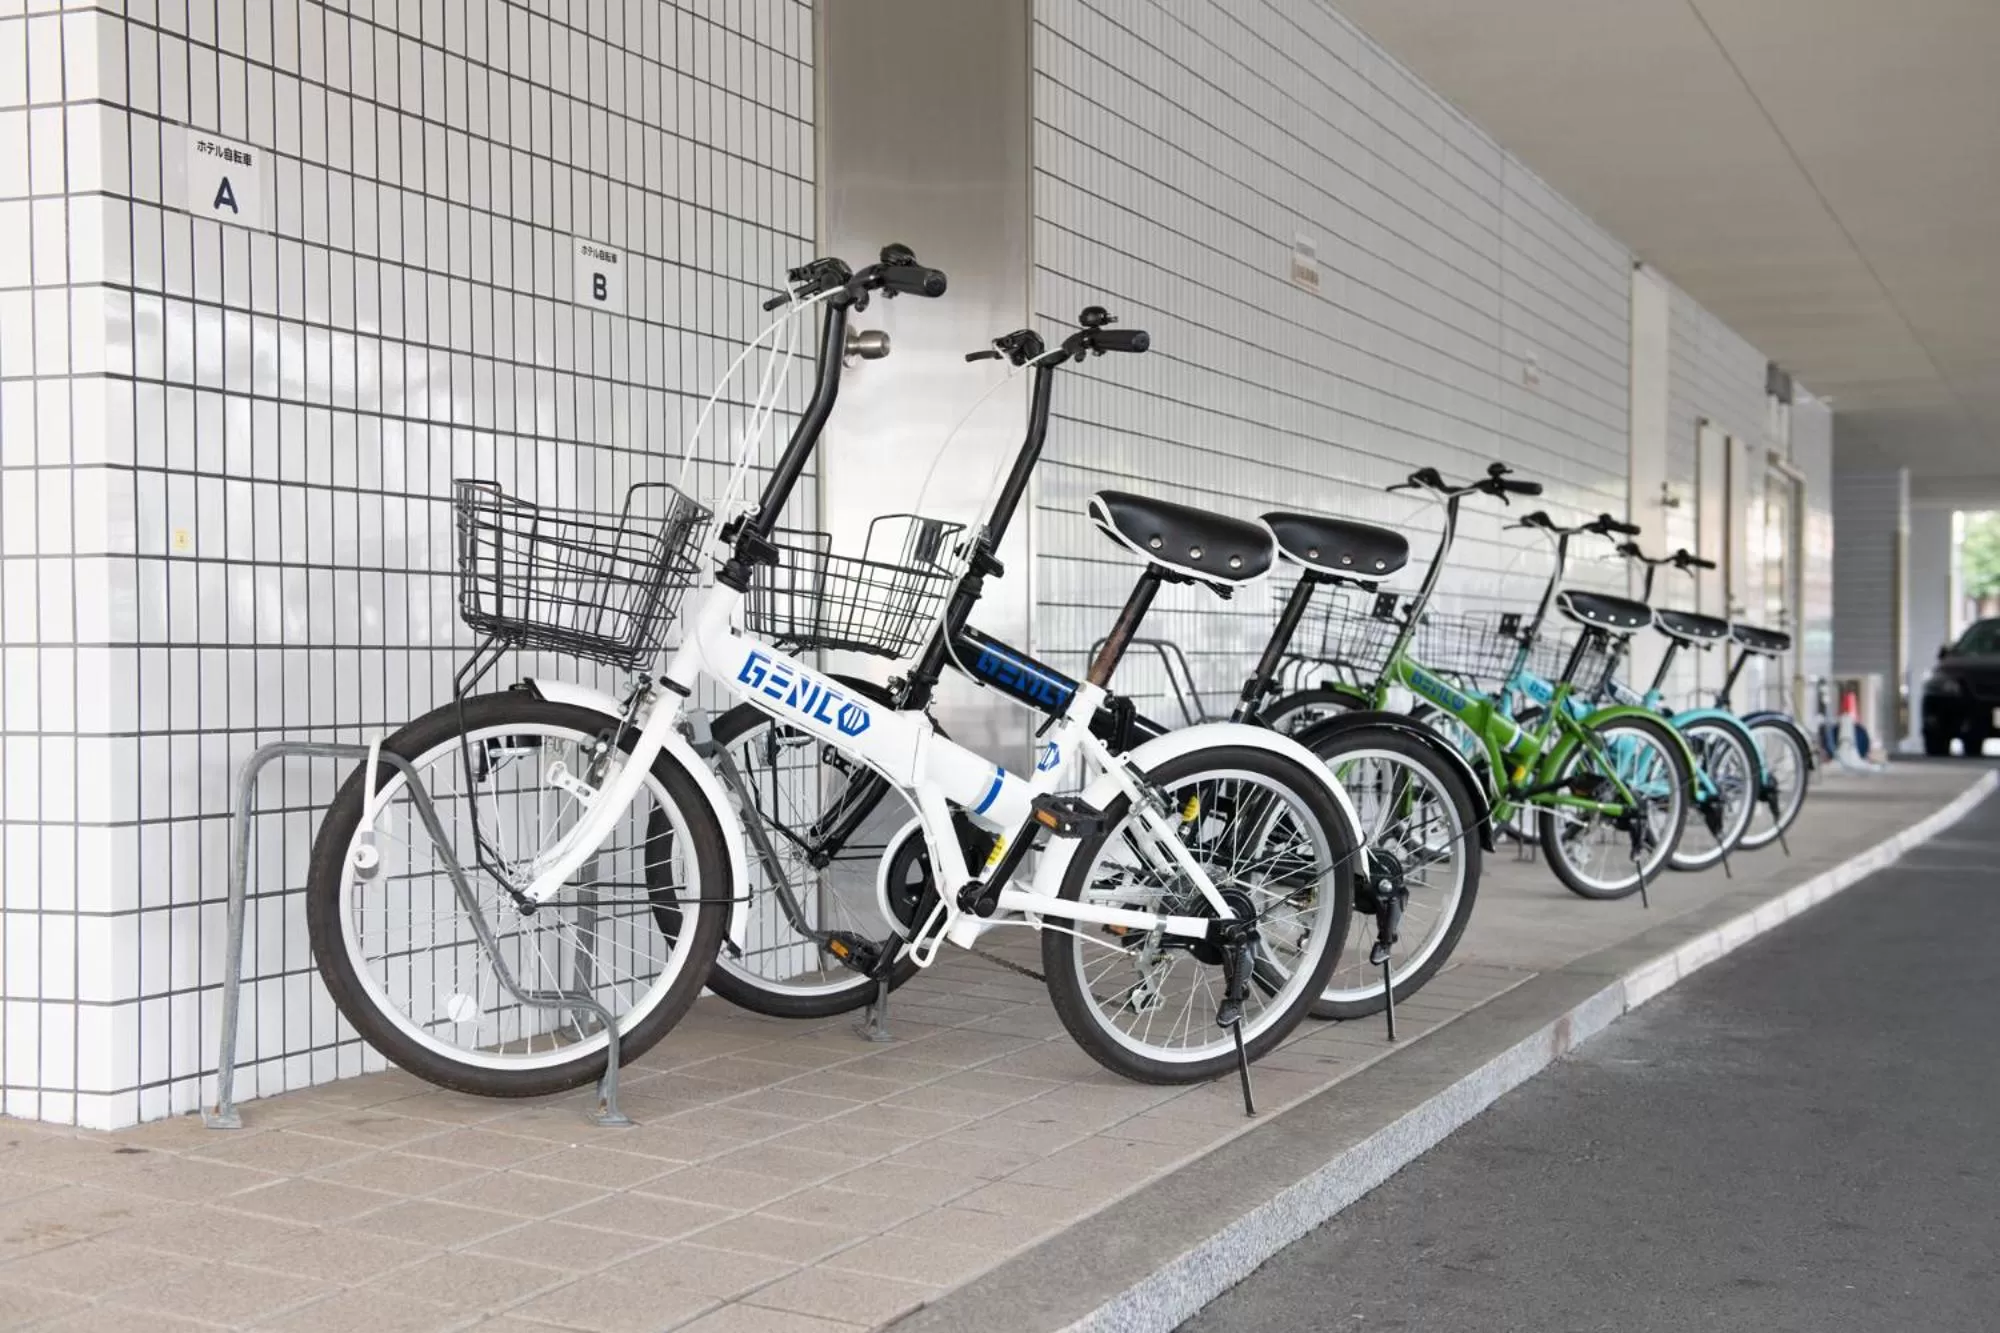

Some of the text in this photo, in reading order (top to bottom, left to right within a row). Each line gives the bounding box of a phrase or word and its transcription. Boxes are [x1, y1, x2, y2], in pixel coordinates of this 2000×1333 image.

[197, 140, 252, 166] ホテル自転車
[213, 176, 238, 214] A
[593, 272, 607, 301] B
